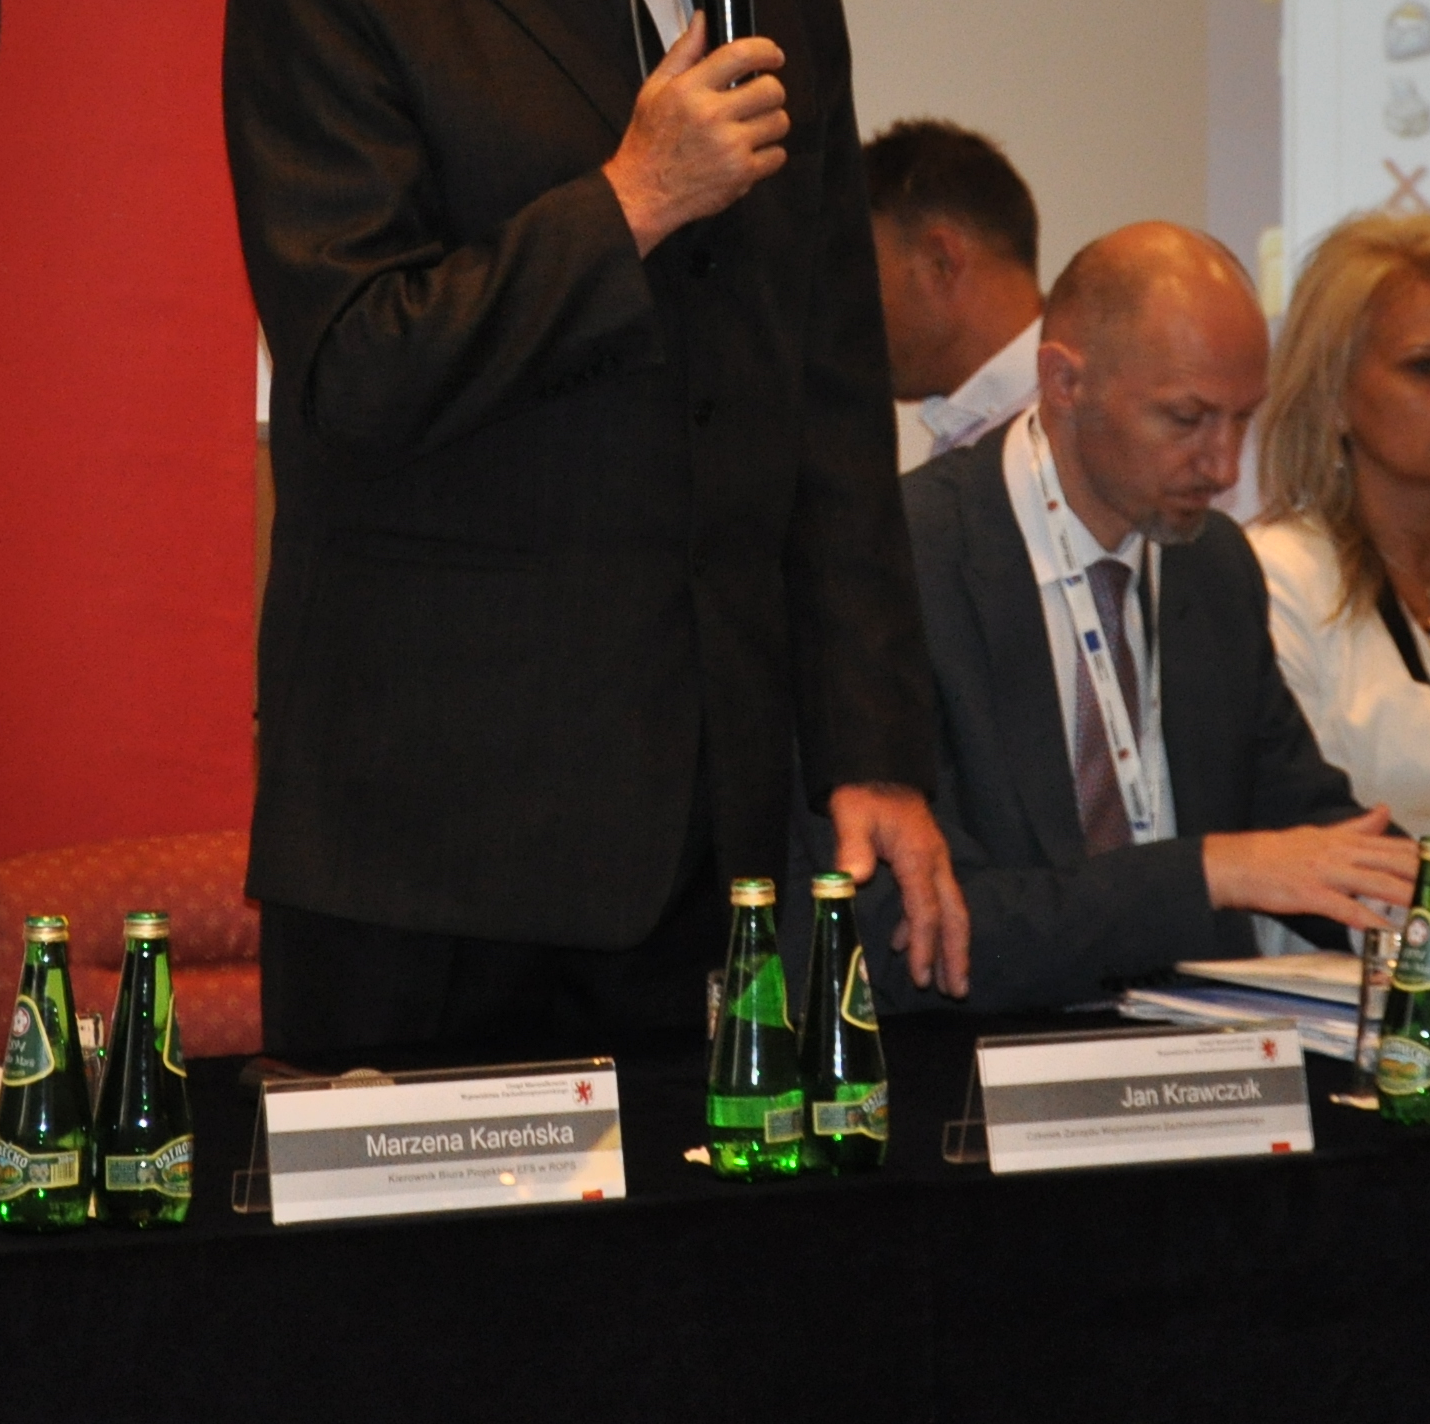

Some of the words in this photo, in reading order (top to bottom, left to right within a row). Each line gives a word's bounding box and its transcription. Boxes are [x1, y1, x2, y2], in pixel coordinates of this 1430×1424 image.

[1121, 1083, 1160, 1109] Jan
[1162, 1077, 1263, 1106] Krawczuk
[366, 1132, 464, 1158] Marzena
[469, 1122, 575, 1151] Kareńska
[438, 1169, 464, 1181] Biura
